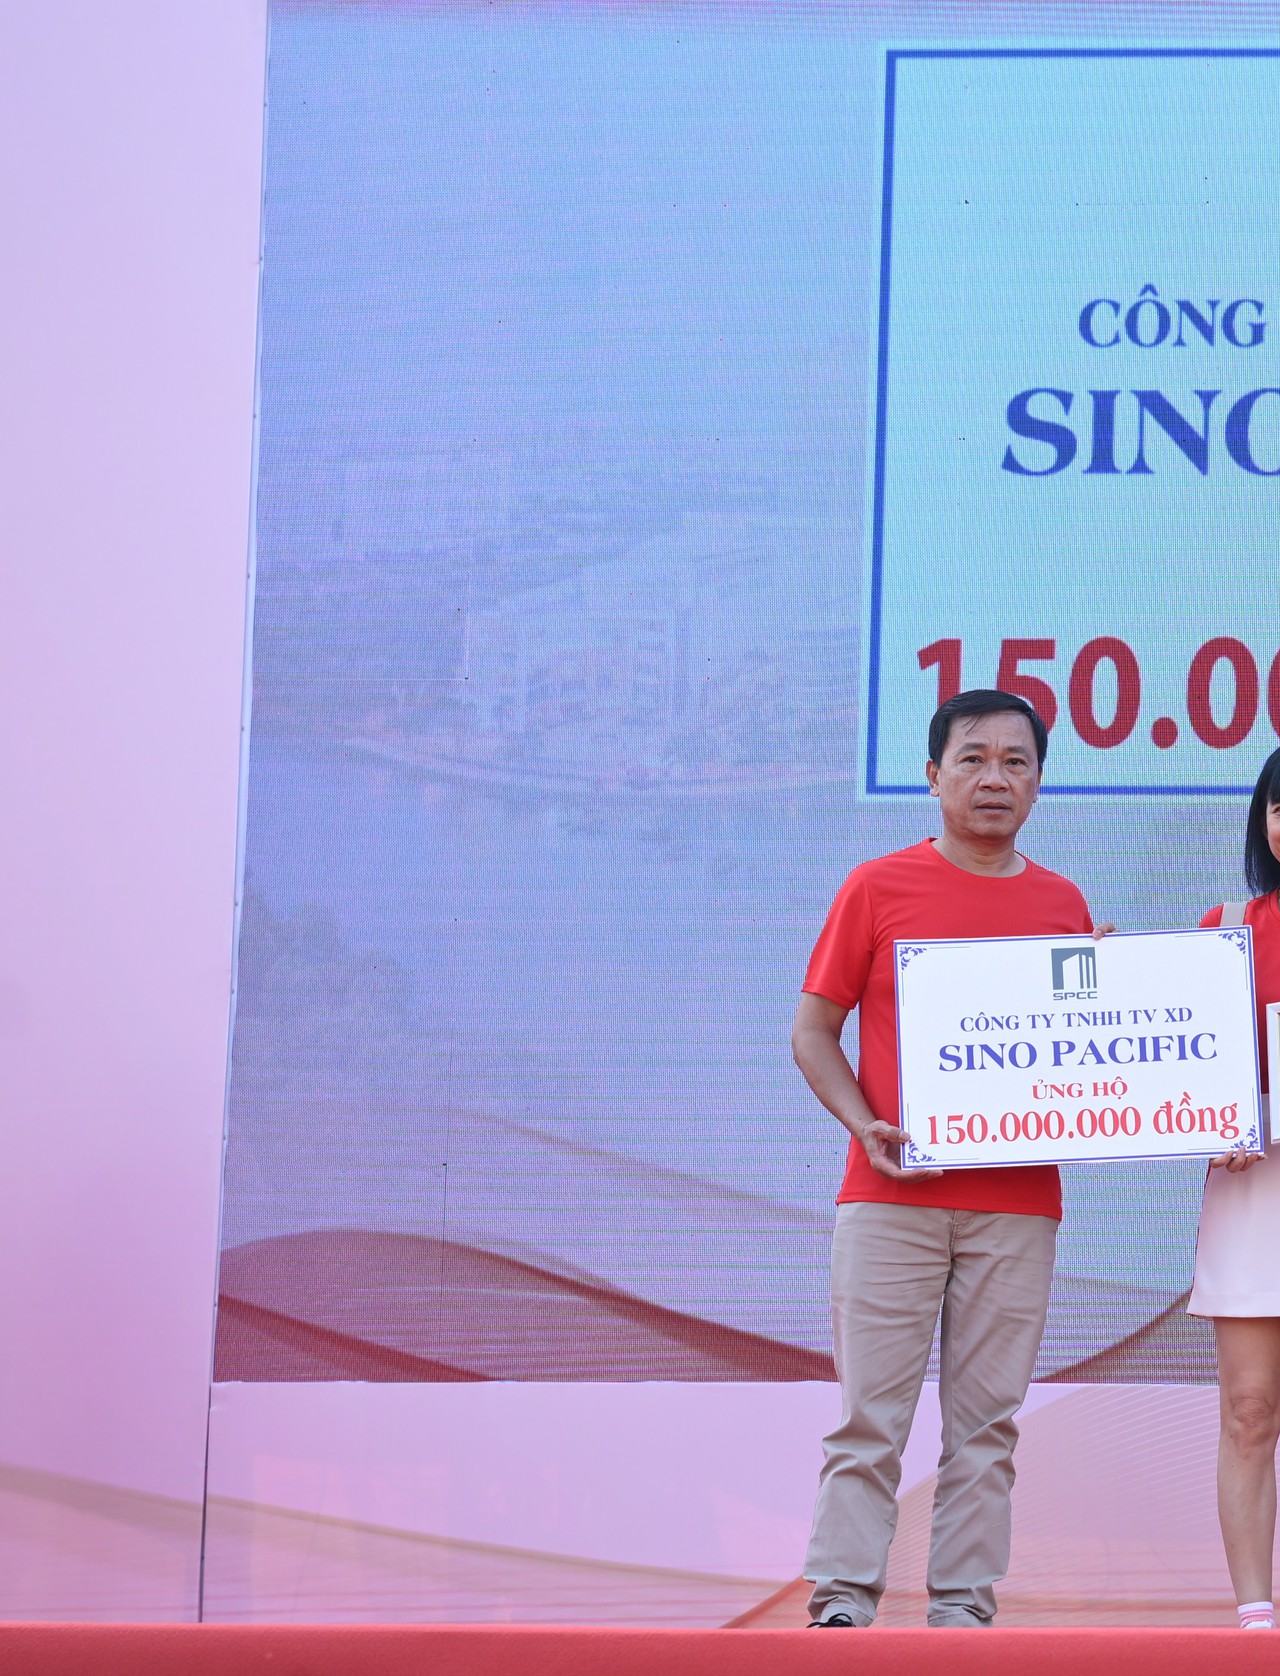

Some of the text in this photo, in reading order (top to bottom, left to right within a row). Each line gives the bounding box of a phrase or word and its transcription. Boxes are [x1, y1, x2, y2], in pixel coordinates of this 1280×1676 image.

[1078, 284, 1266, 349] CÔNG
[1052, 991, 1098, 1001] SPCC
[960, 1007, 1193, 1032] CÔNG TY TNHH TV XD
[938, 1032, 1218, 1072] SINO PACIFIC
[1032, 1076, 1129, 1101] ỦNG HỘ
[928, 1091, 1240, 1145] 150.000.000 đồng
